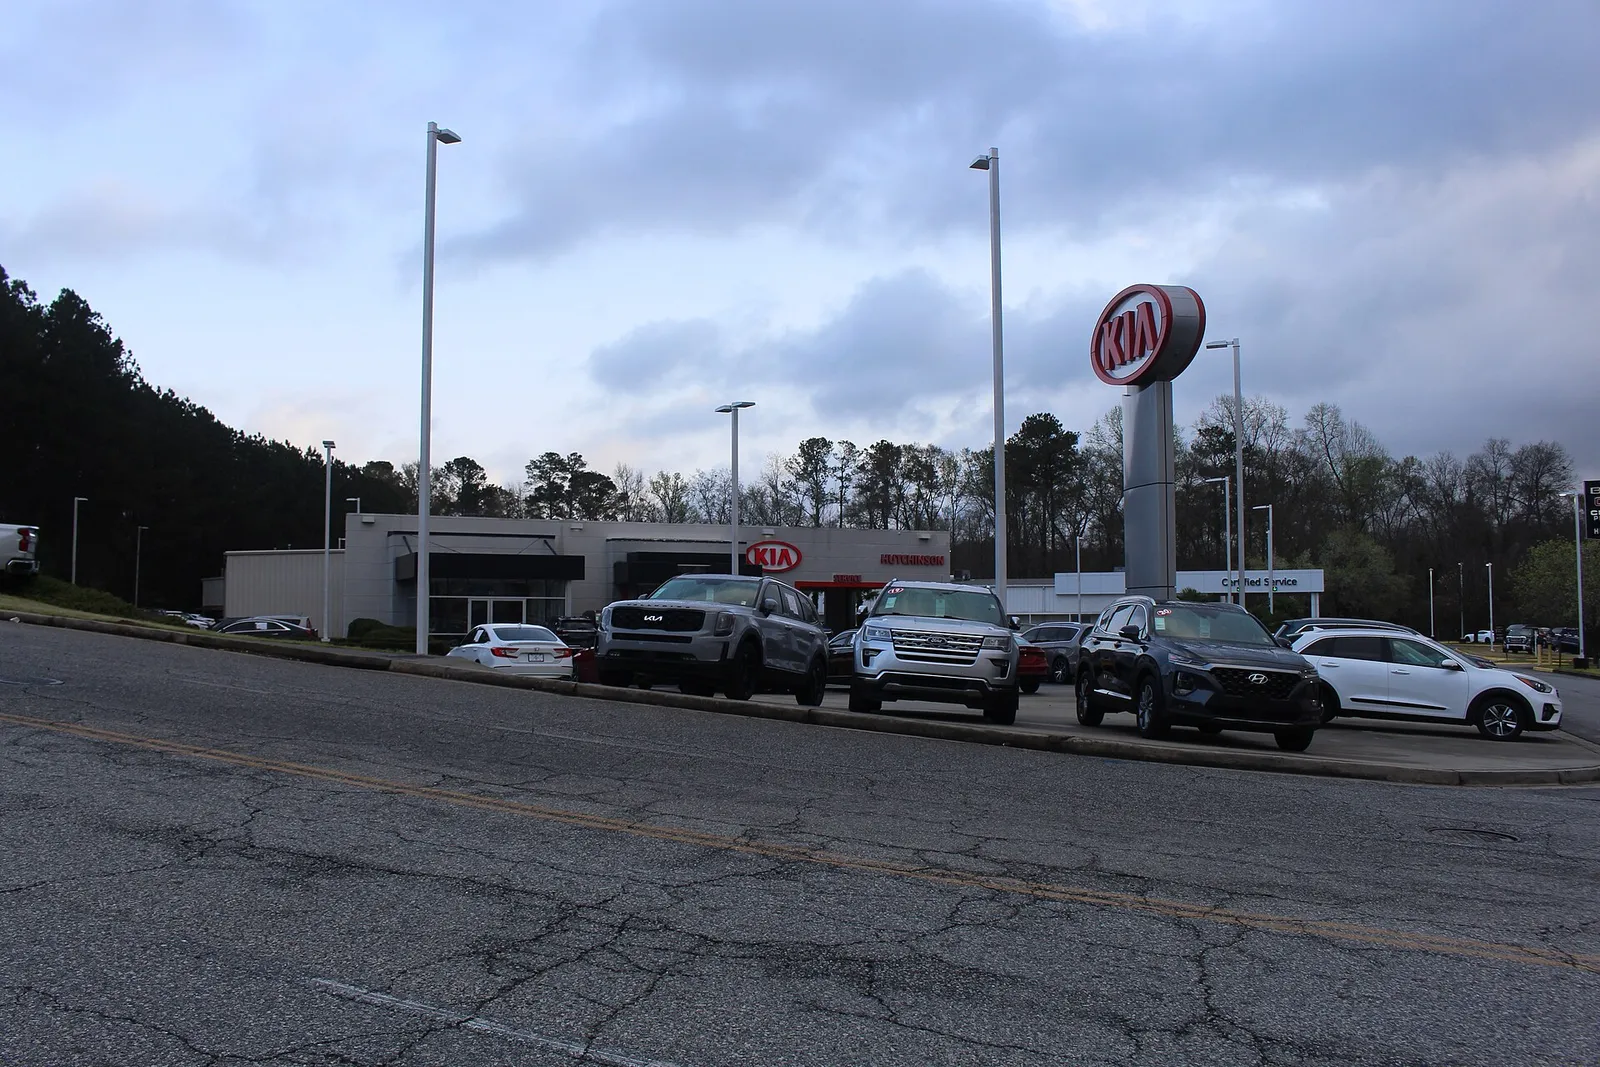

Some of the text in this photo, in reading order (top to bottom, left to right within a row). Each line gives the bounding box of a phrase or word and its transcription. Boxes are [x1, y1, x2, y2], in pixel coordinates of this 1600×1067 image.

[1103, 302, 1158, 370] KIA
[754, 548, 792, 566] KIA
[881, 554, 944, 565] HUTCHINSON
[1221, 577, 1261, 587] Certfied
